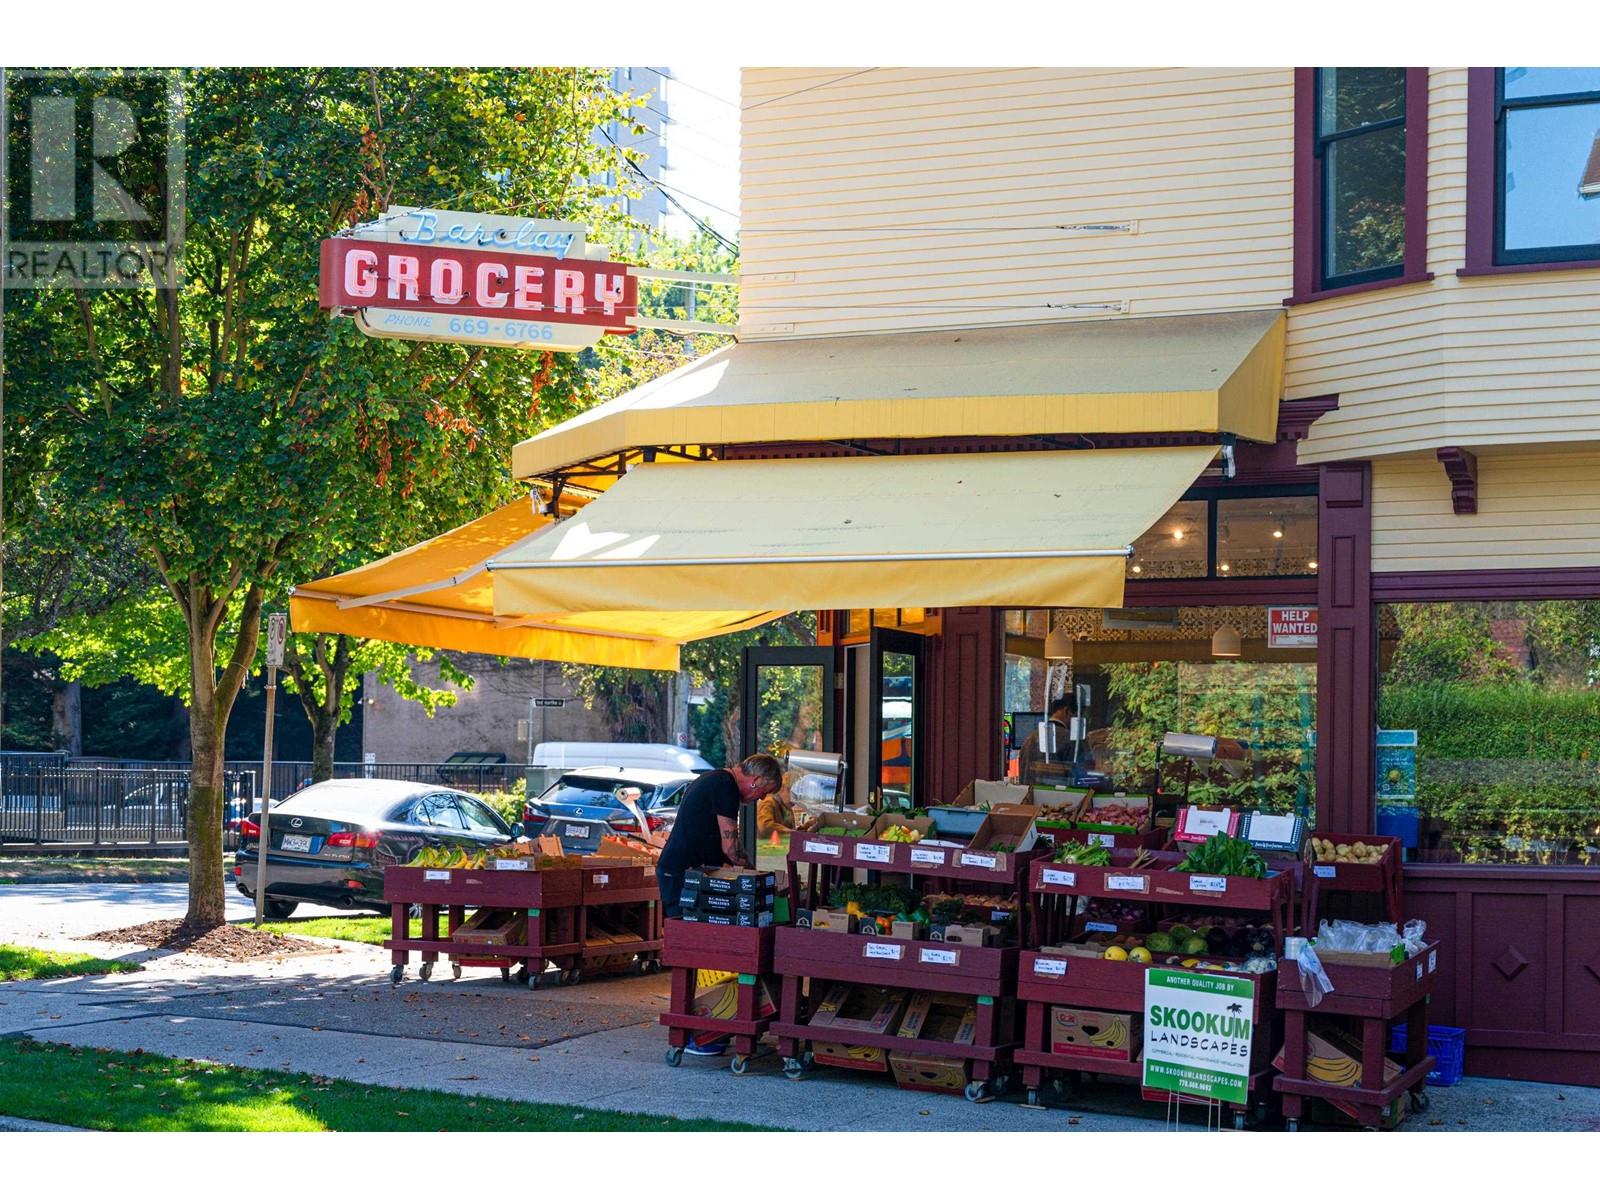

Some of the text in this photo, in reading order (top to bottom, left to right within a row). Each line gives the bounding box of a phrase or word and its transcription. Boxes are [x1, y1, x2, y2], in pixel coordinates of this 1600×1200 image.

[400, 211, 576, 260] Barclay
[344, 249, 625, 316] GROCERY
[384, 312, 433, 328] PHONE
[1281, 610, 1310, 622] HELP
[1273, 622, 1318, 634] WANTED
[1166, 976, 1234, 992] ANOTHER QUALITY JOB BY
[1150, 1004, 1250, 1041] SKOOKUM
[1151, 1030, 1248, 1057] LANDSCAPES
[1149, 1065, 1243, 1088] WWW.SKOOKUMLANDSCAPES.COM
